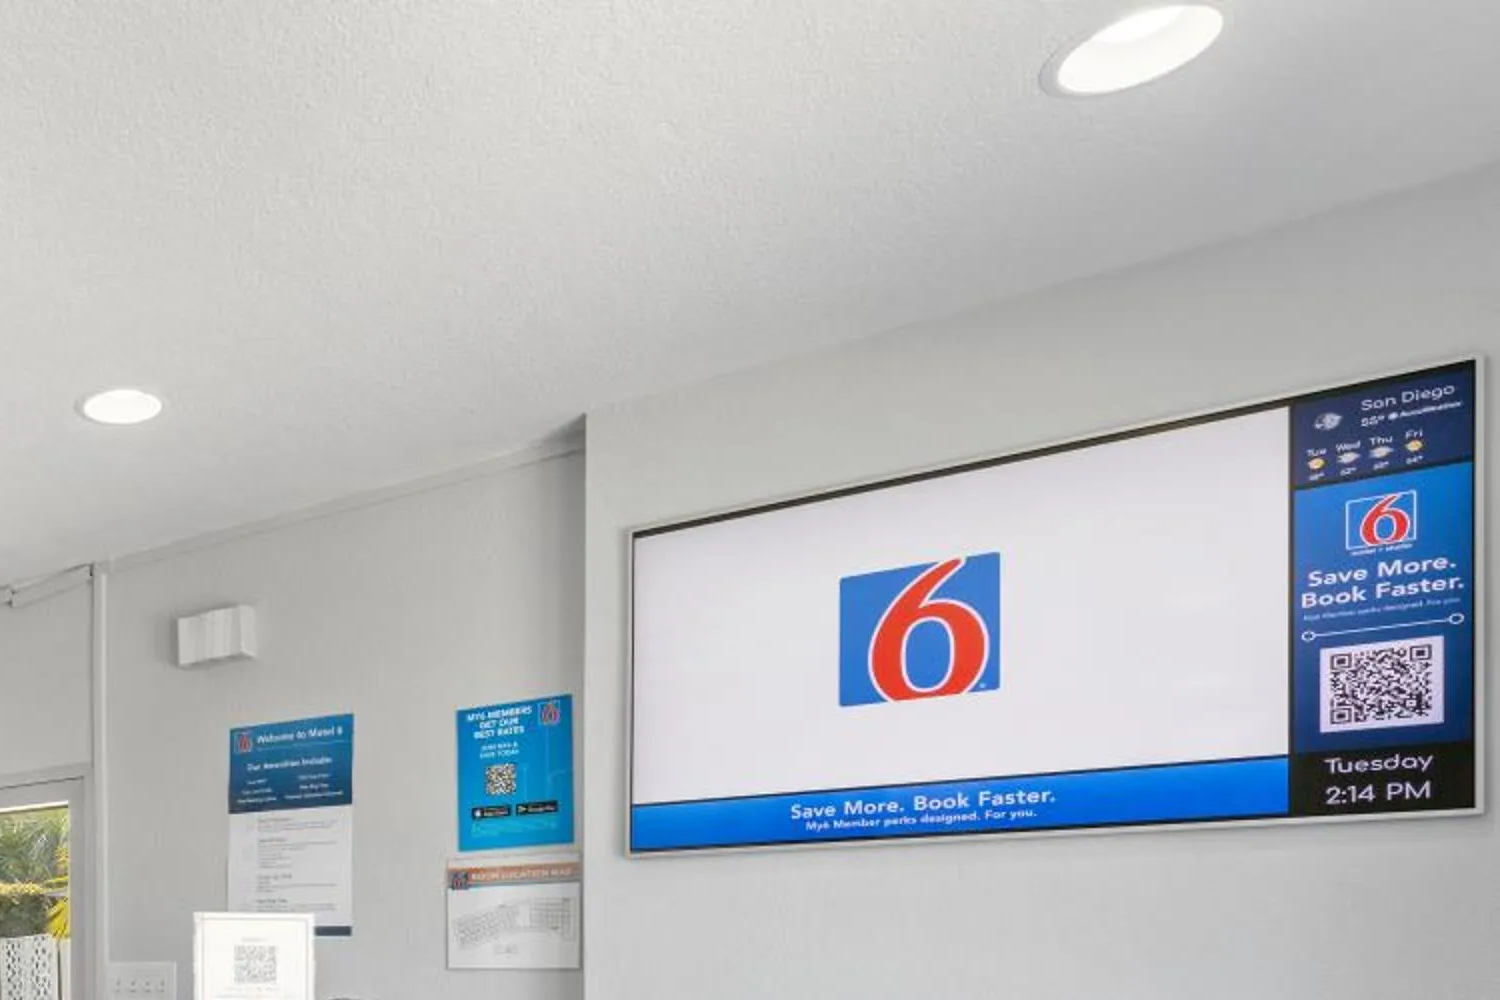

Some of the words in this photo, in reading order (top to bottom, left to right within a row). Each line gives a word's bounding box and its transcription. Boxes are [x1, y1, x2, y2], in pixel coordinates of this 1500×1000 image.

[1361, 397, 1397, 411] San
[1401, 385, 1455, 403] Diego
[1336, 440, 1361, 452] Wed
[1369, 436, 1393, 446] Thu
[1405, 429, 1423, 439] Fri
[1359, 492, 1411, 546] 6
[1307, 568, 1368, 587] Save
[1377, 556, 1457, 577] More.
[1301, 585, 1367, 609] Book
[1375, 575, 1465, 599] Faster.
[868, 557, 990, 702] 6
[1324, 754, 1434, 774] Tuesday
[790, 803, 837, 820] Save
[843, 799, 904, 816] More.
[913, 790, 970, 811] Book
[978, 789, 1055, 807] Faster.
[1325, 784, 1376, 805] 2:14
[1387, 780, 1432, 801] PM
[833, 818, 880, 830] Member
[883, 815, 917, 828] perks
[920, 811, 981, 824] designed.
[984, 809, 1007, 820] For
[1010, 807, 1038, 819] you.
